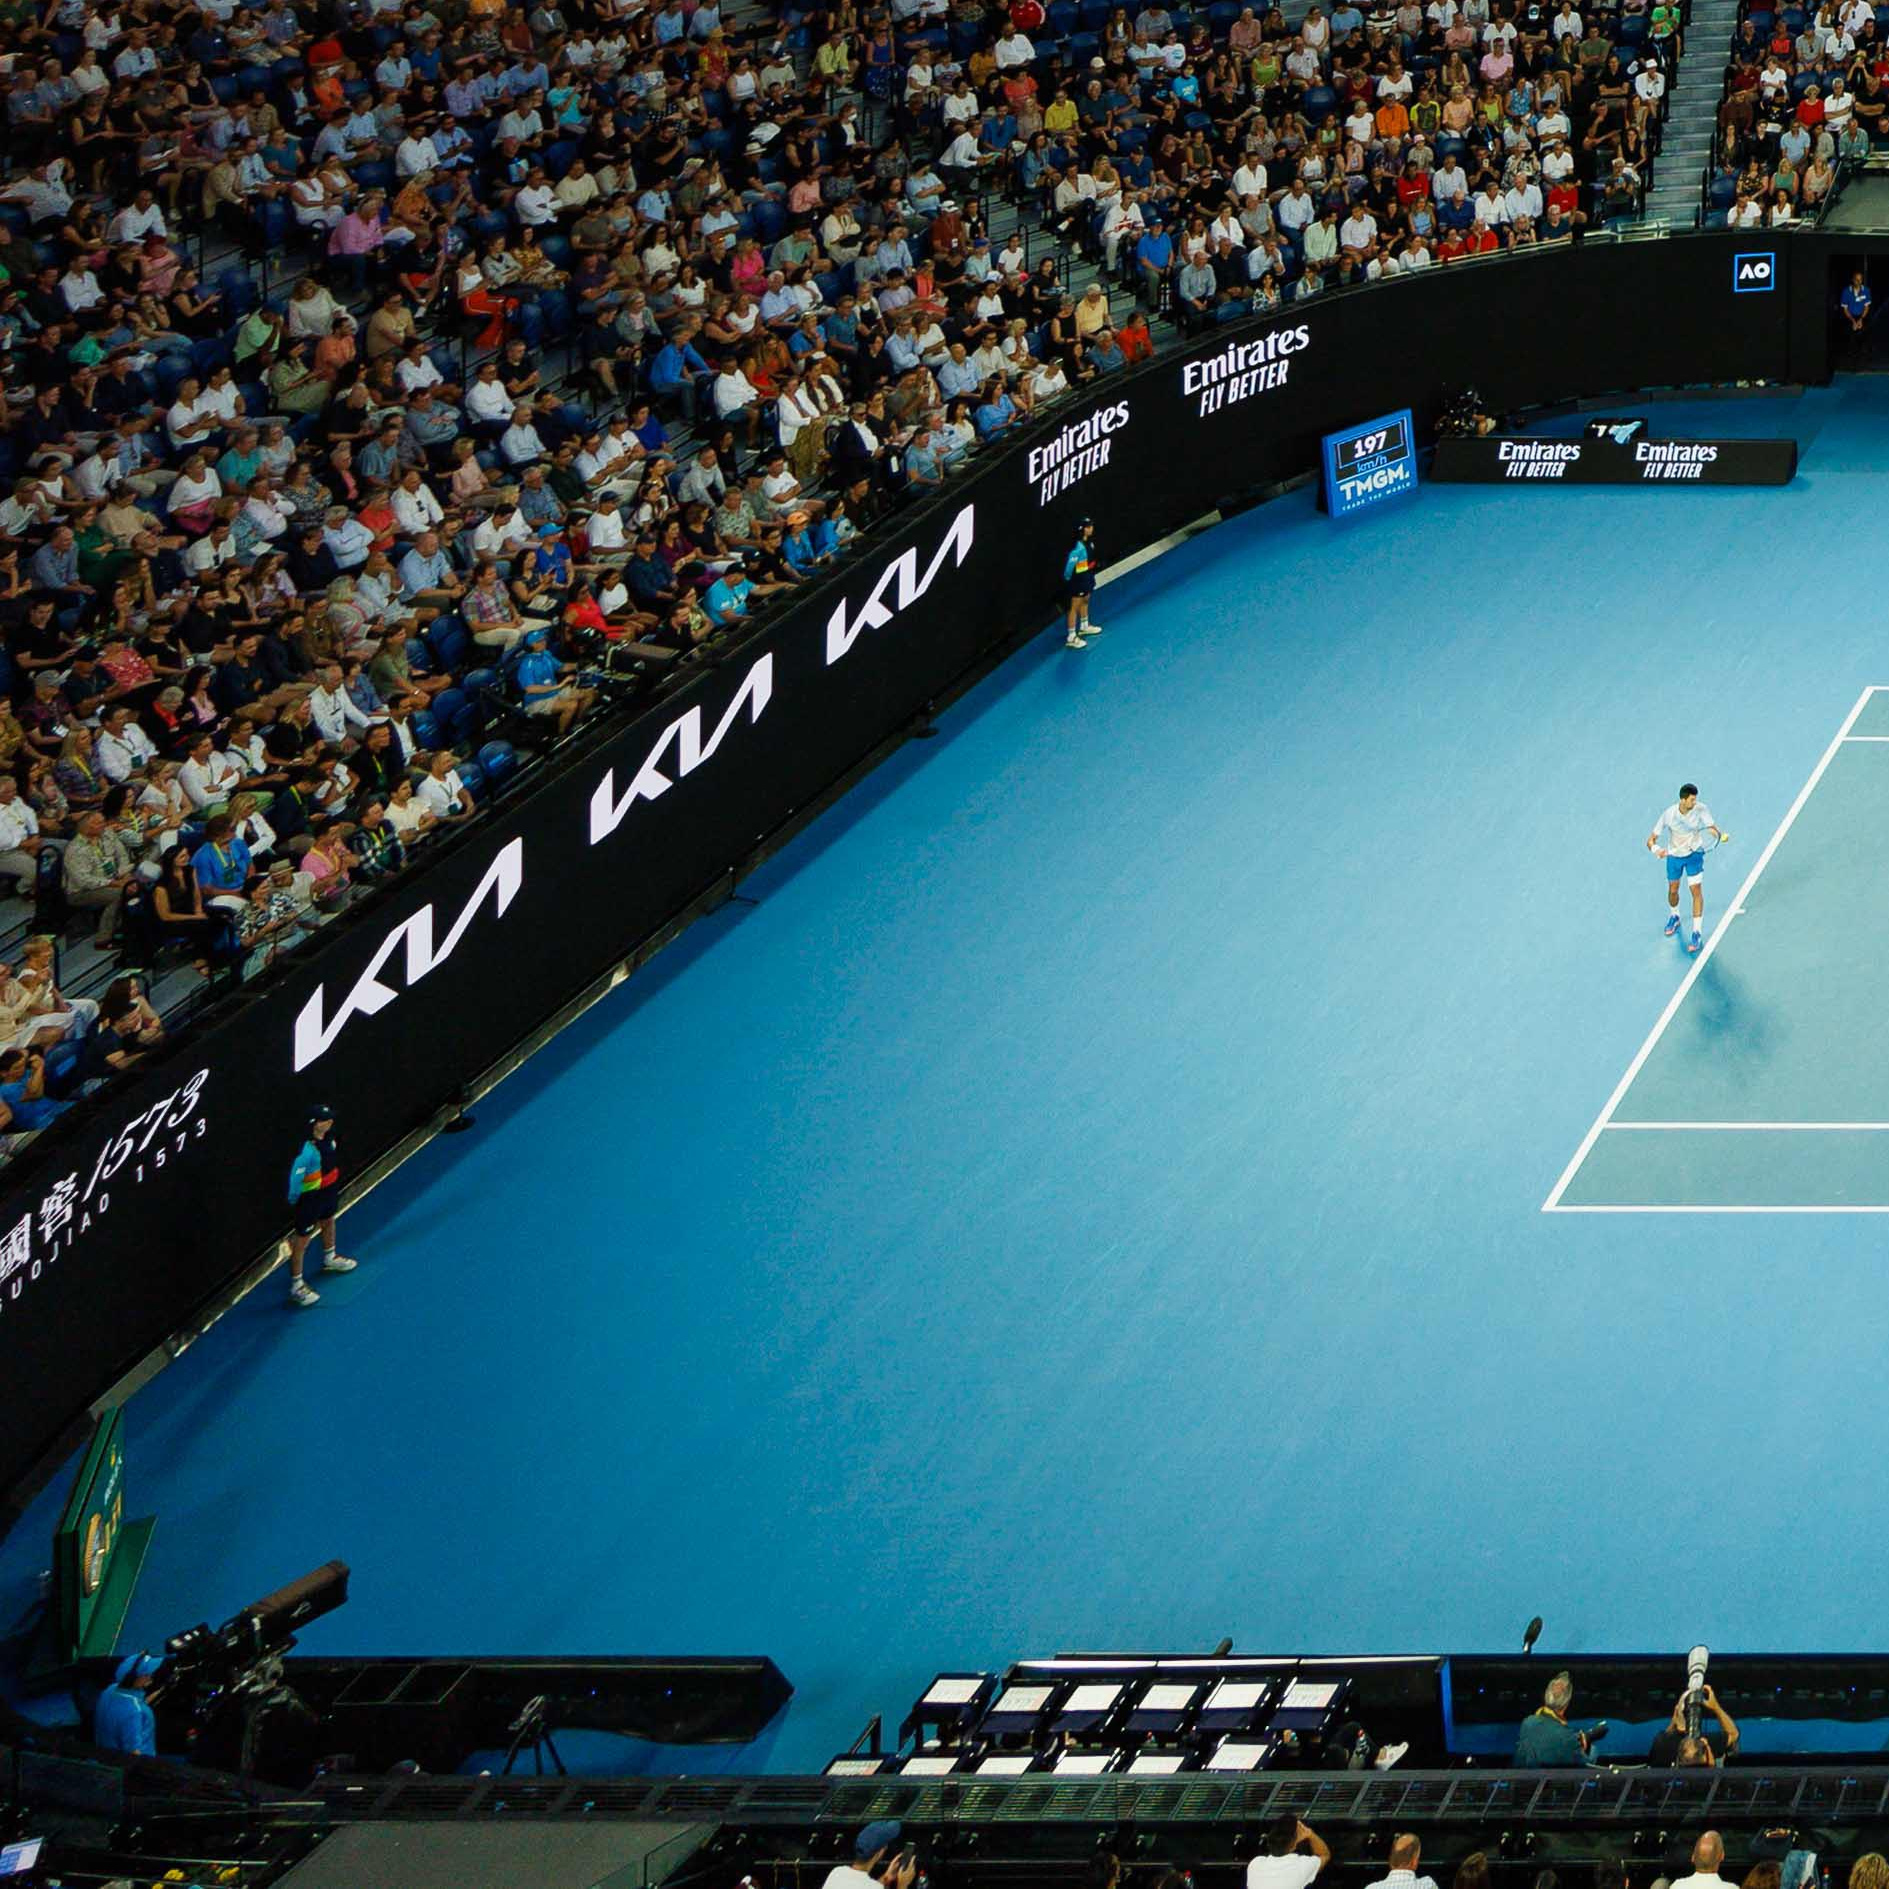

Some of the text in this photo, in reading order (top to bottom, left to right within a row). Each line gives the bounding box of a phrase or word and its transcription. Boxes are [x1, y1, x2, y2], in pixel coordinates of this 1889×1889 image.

[1738, 263, 1770, 280] AO
[1183, 324, 1310, 396] Emirates
[1200, 359, 1290, 418] FLY BETTER
[1028, 400, 1130, 484] Emirates
[1354, 431, 1387, 458] 197
[1499, 441, 1581, 461] Emirates
[1636, 442, 1718, 462] Emirates
[1040, 438, 1111, 507] FLY BETTER
[1357, 455, 1387, 472] km/h
[1505, 462, 1566, 478] FLY BETTER
[1643, 462, 1703, 479] FLY BETTER
[0, 1118, 206, 1312] UOJIAO 1573
